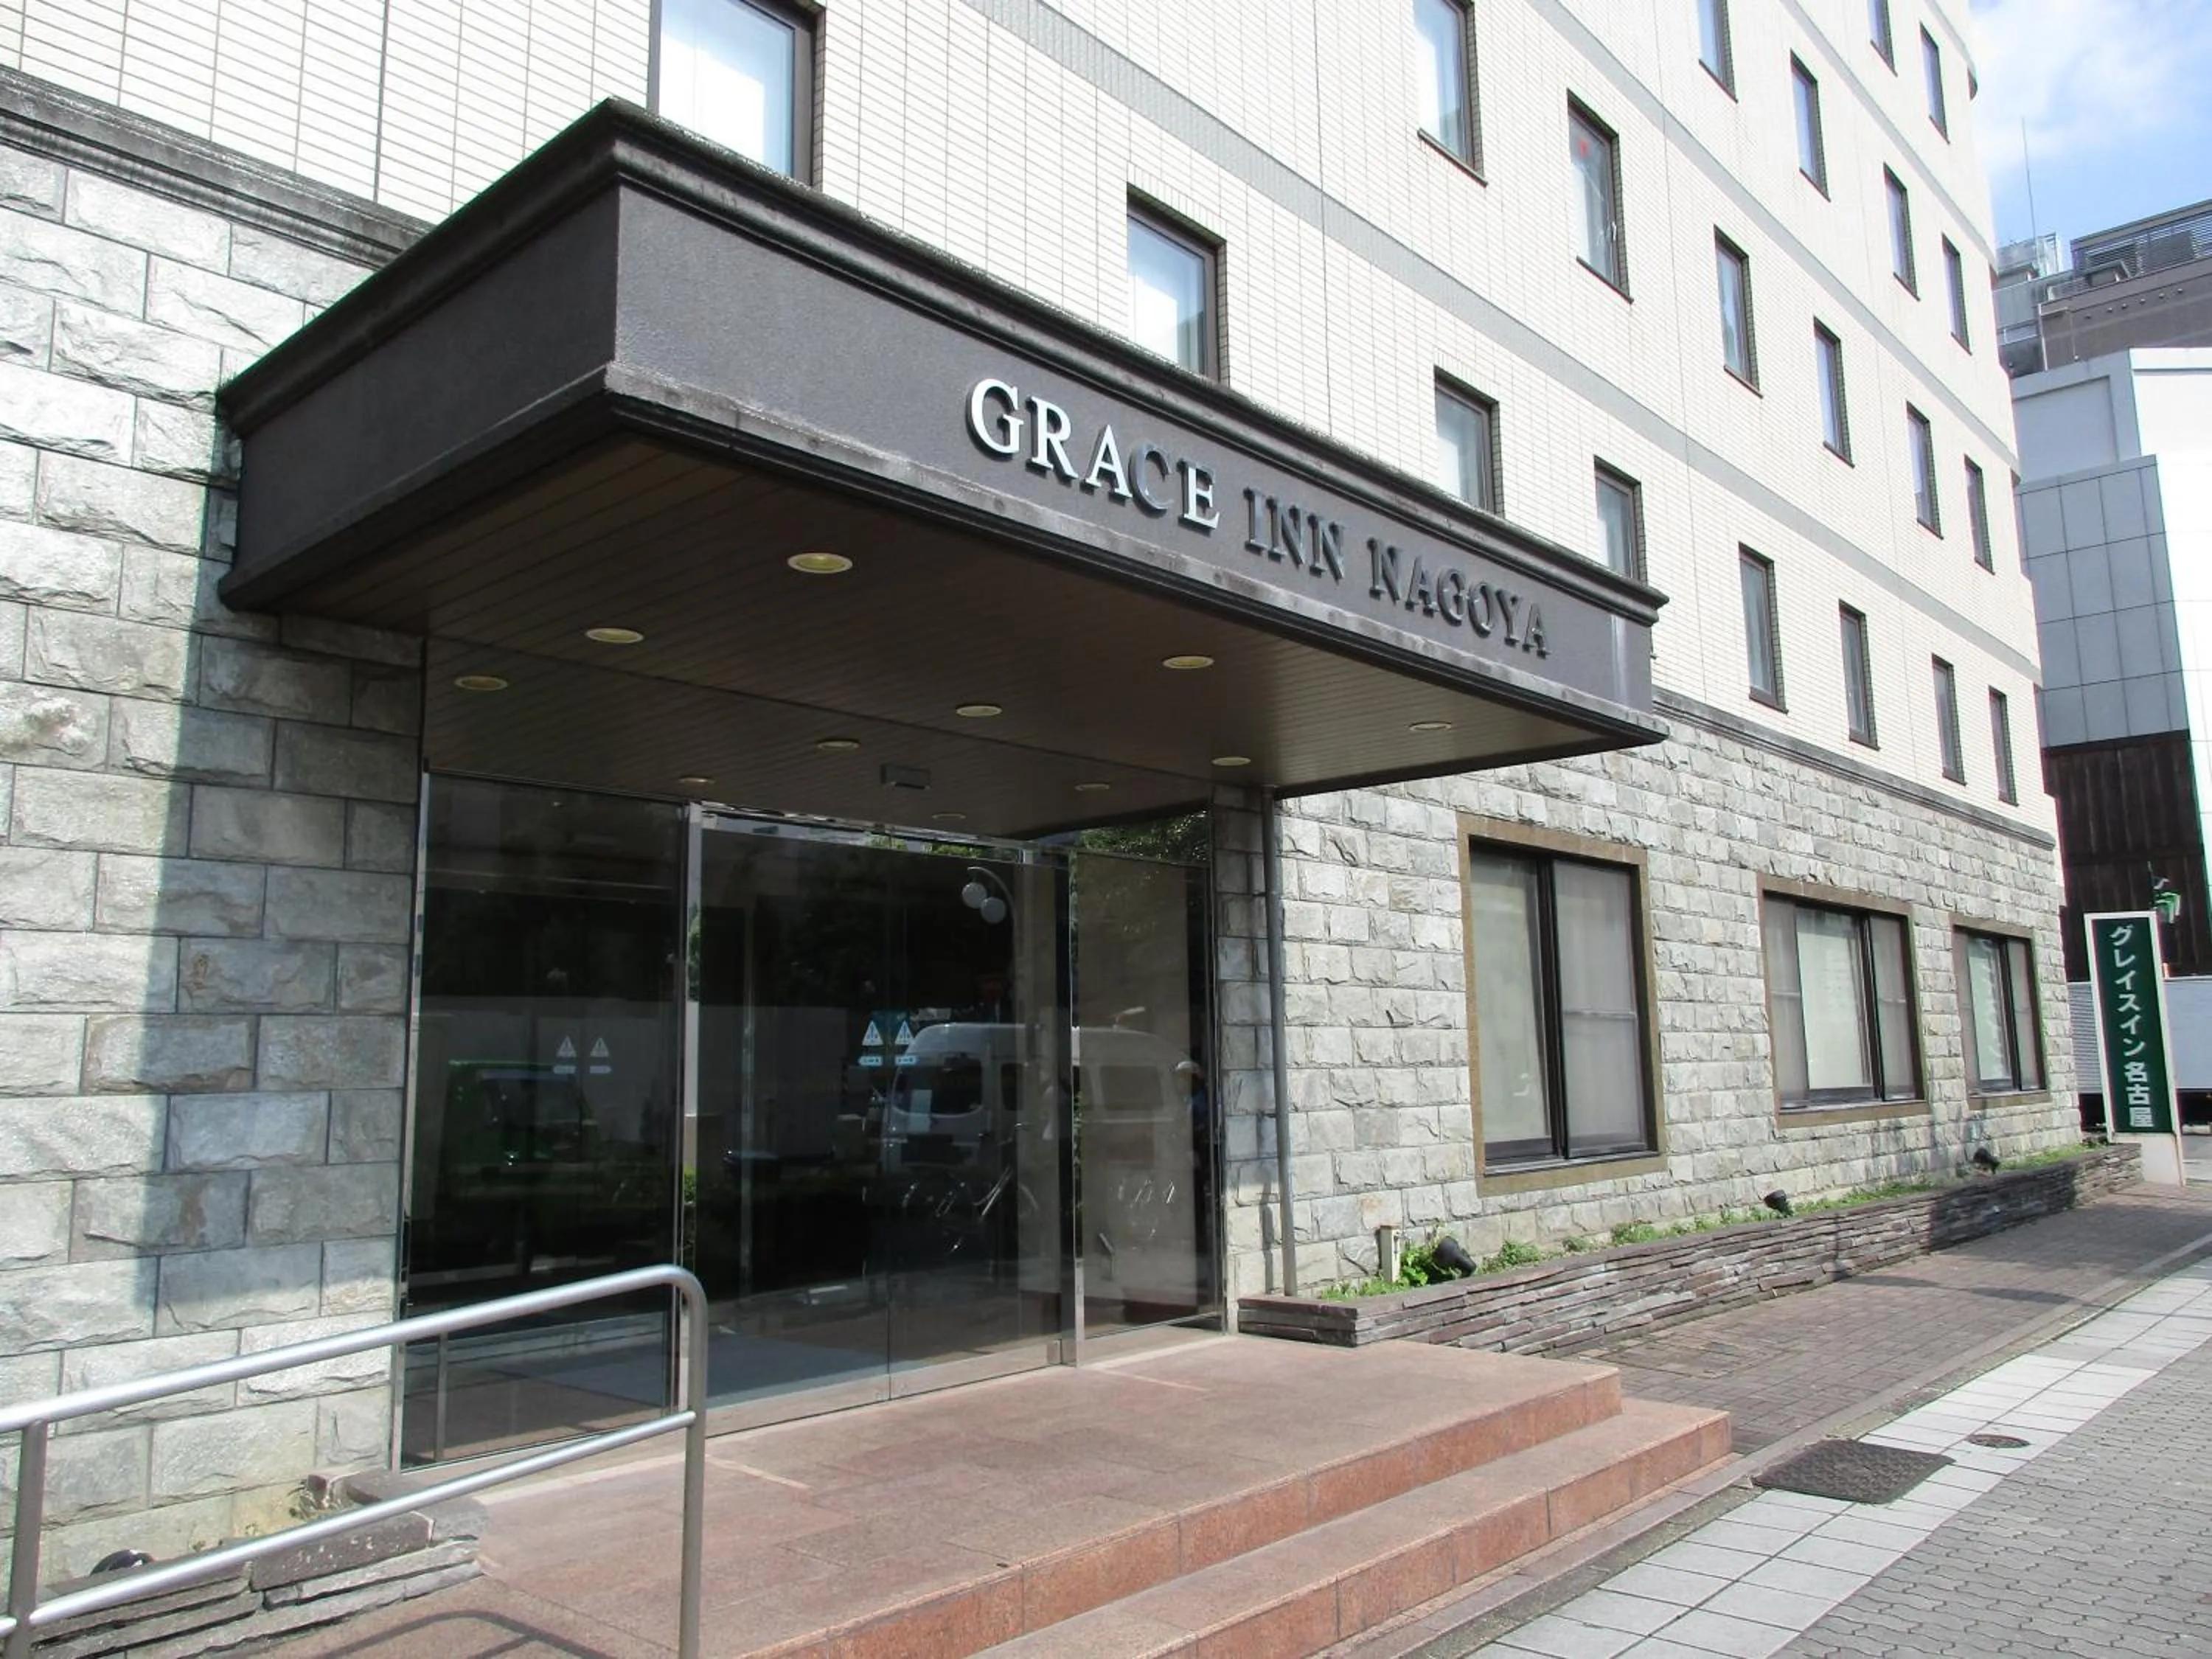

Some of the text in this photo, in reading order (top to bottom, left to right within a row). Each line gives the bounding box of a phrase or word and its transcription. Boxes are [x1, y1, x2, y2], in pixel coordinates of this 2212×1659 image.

[966, 378, 1550, 658] GRACE INN NAGOYA
[2109, 923, 2154, 1127] グレイスイン名古屋
